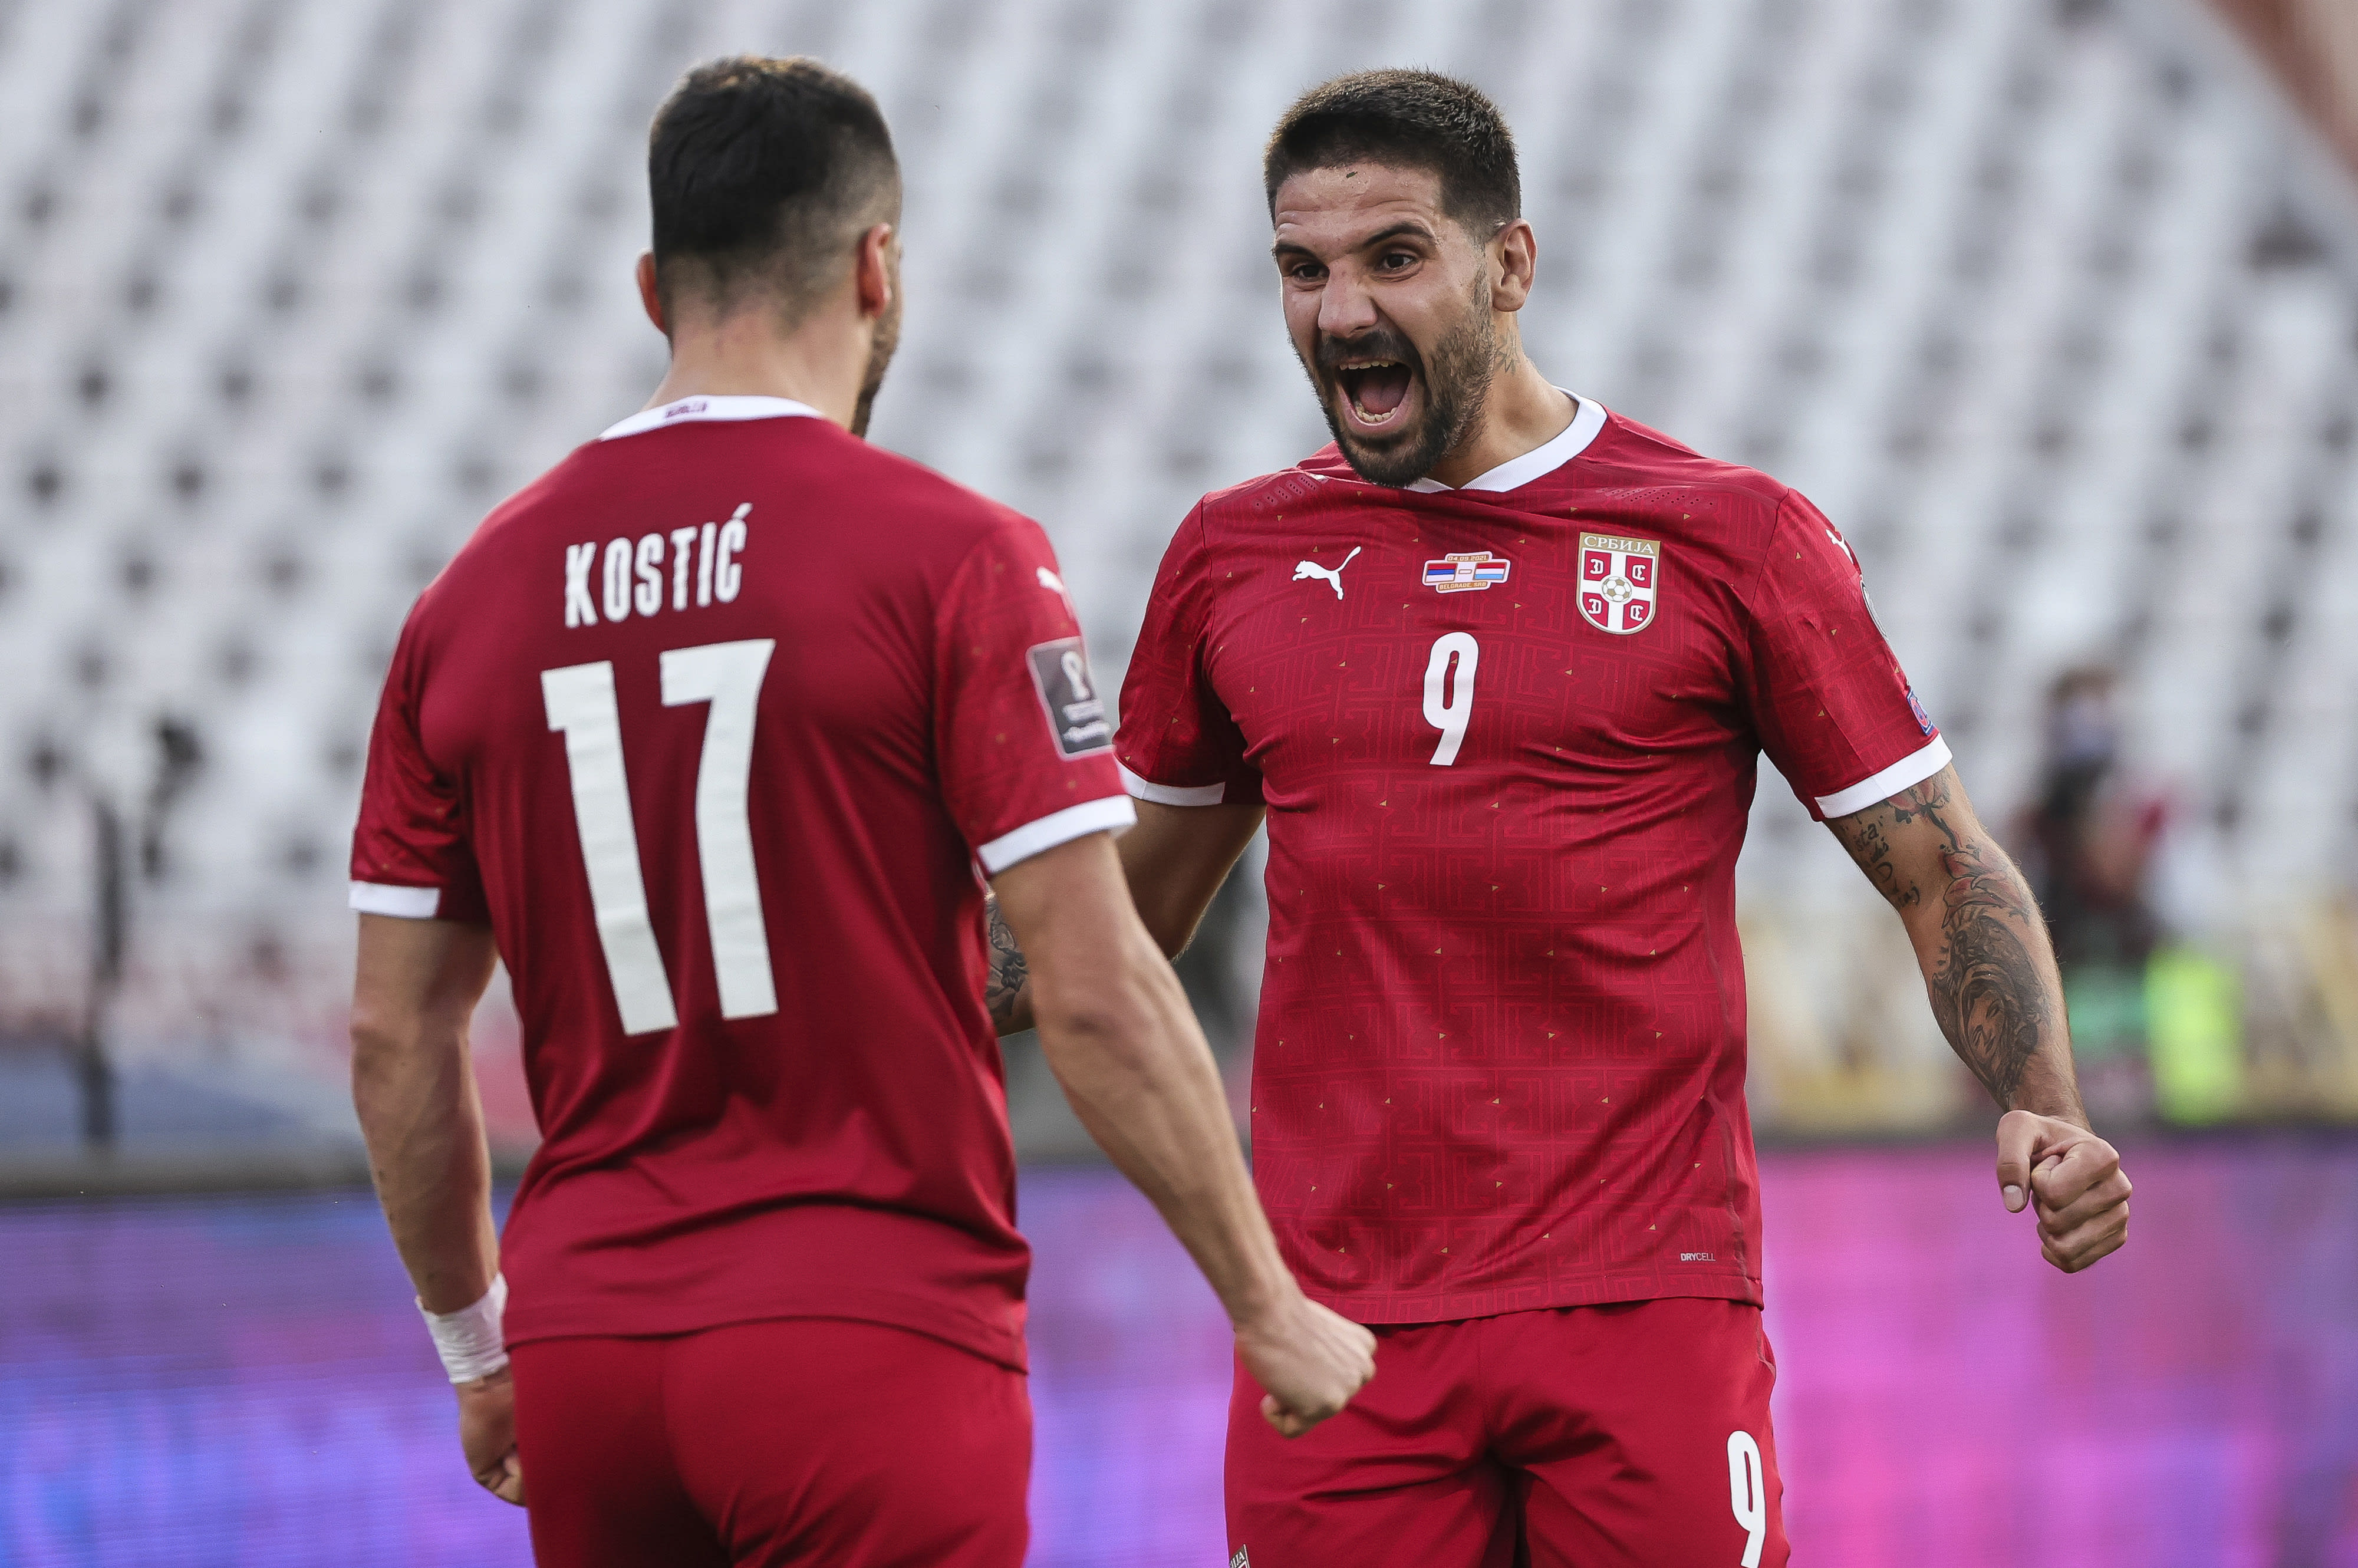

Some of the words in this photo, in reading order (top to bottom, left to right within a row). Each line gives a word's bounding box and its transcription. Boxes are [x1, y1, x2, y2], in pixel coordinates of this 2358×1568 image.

[565, 502, 753, 628] KOSTIĆ
[1583, 535, 1655, 554] СРБИЈА
[1422, 631, 1479, 766] 9
[540, 638, 778, 1036] 17
[1680, 1253, 1716, 1261] DRYCELL
[1727, 1430, 1766, 1568] 9
